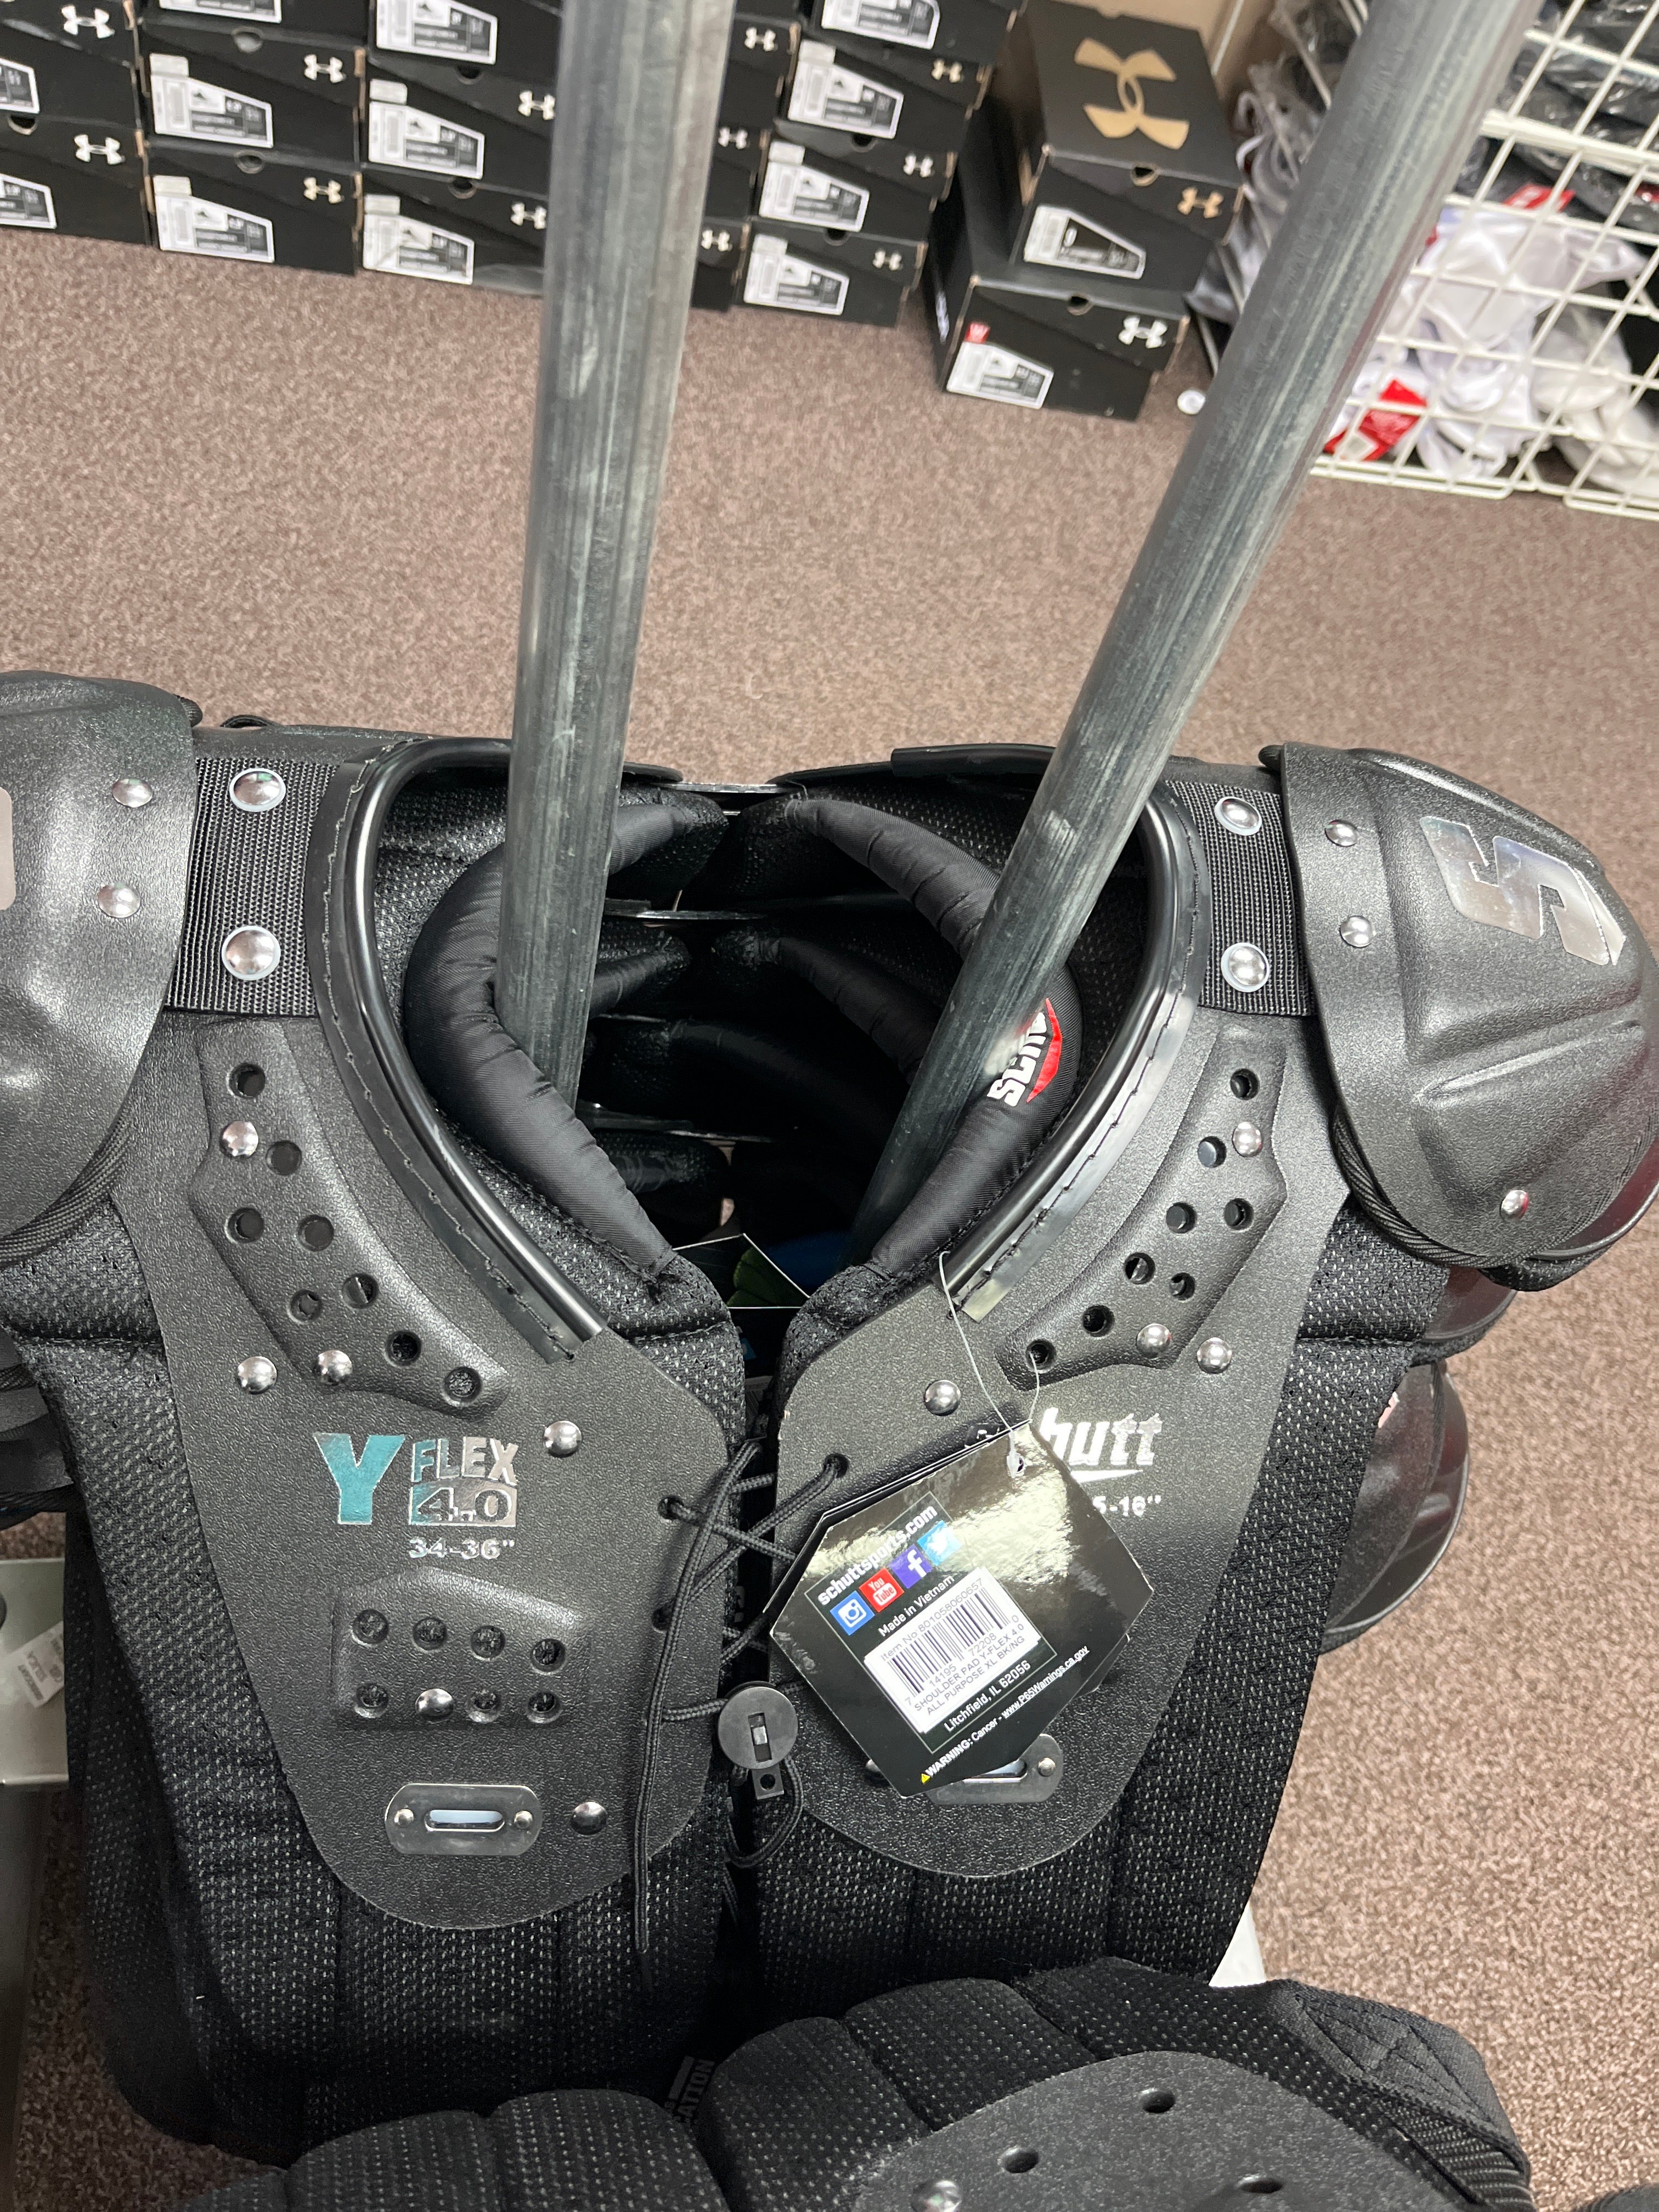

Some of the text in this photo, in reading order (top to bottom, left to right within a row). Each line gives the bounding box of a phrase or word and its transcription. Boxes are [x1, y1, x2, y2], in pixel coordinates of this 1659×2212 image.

[313, 1433, 519, 1525] Y FLEX
[415, 1486, 514, 1524] 4.0
[818, 1506, 938, 1605] schuttsports.com
[868, 1578, 885, 1591] You
[875, 1587, 894, 1602] Tube
[878, 1574, 955, 1637] Made in Vietnam
[881, 1644, 902, 1661] Item
[918, 1578, 982, 1632] 801058060657
[915, 1623, 1024, 1711] SHOULDER PAD Y-FLEX 4.0
[927, 1636, 1025, 1715] ALL PURPOSE XL BK/NG
[929, 1663, 956, 1686] 14195
[968, 1633, 996, 1656] 72208
[944, 1660, 1030, 1731] Litchfield, IL 62056
[925, 1738, 973, 1778] WARNING:
[971, 1718, 998, 1741] Cancer
